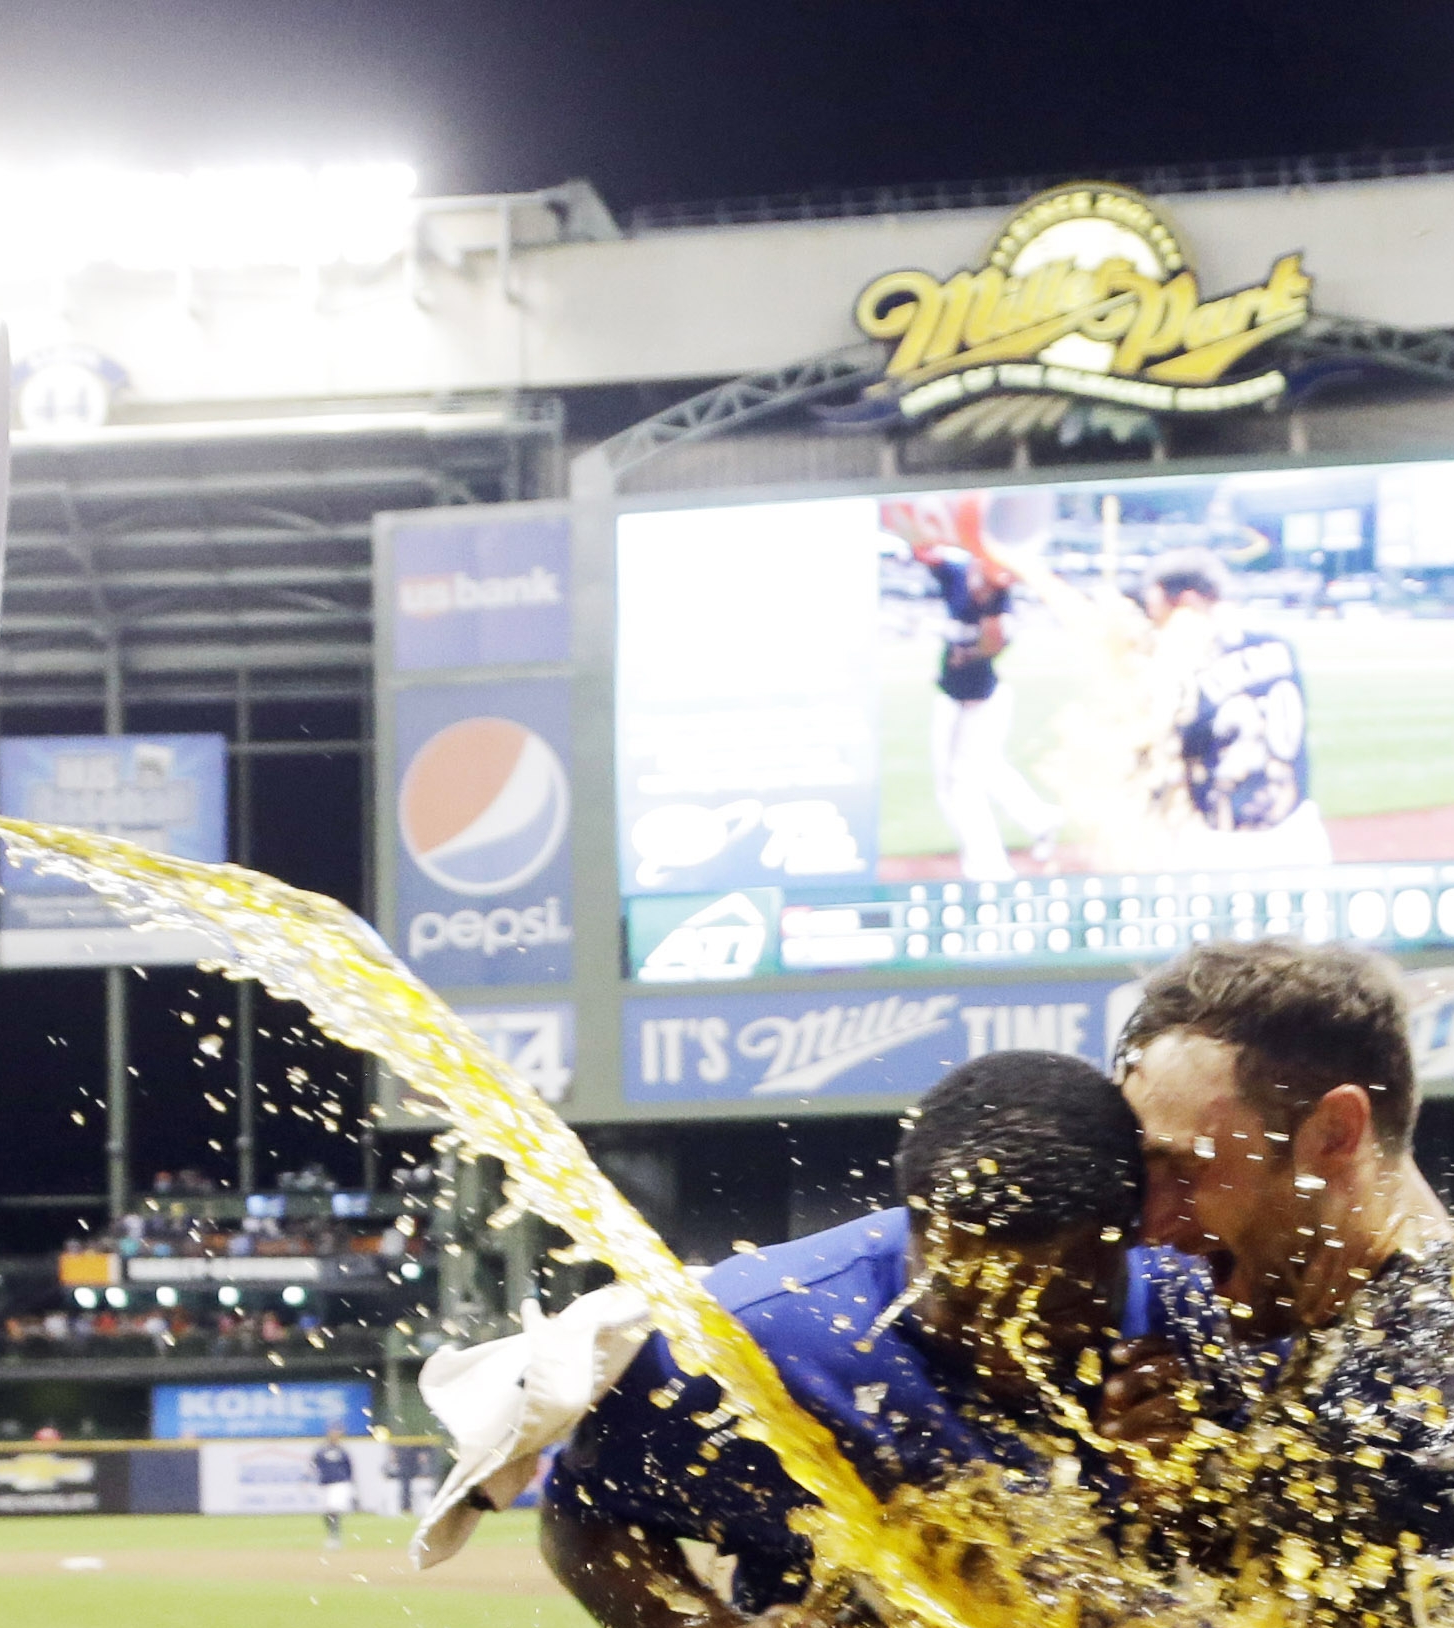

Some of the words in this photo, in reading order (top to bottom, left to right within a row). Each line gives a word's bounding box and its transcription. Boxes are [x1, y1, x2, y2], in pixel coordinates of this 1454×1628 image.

[1081, 252, 1312, 384] Park
[454, 566, 562, 611] bank
[409, 899, 571, 957] pepsi
[640, 1017, 730, 1084] IT'S
[737, 995, 959, 1094] Miller
